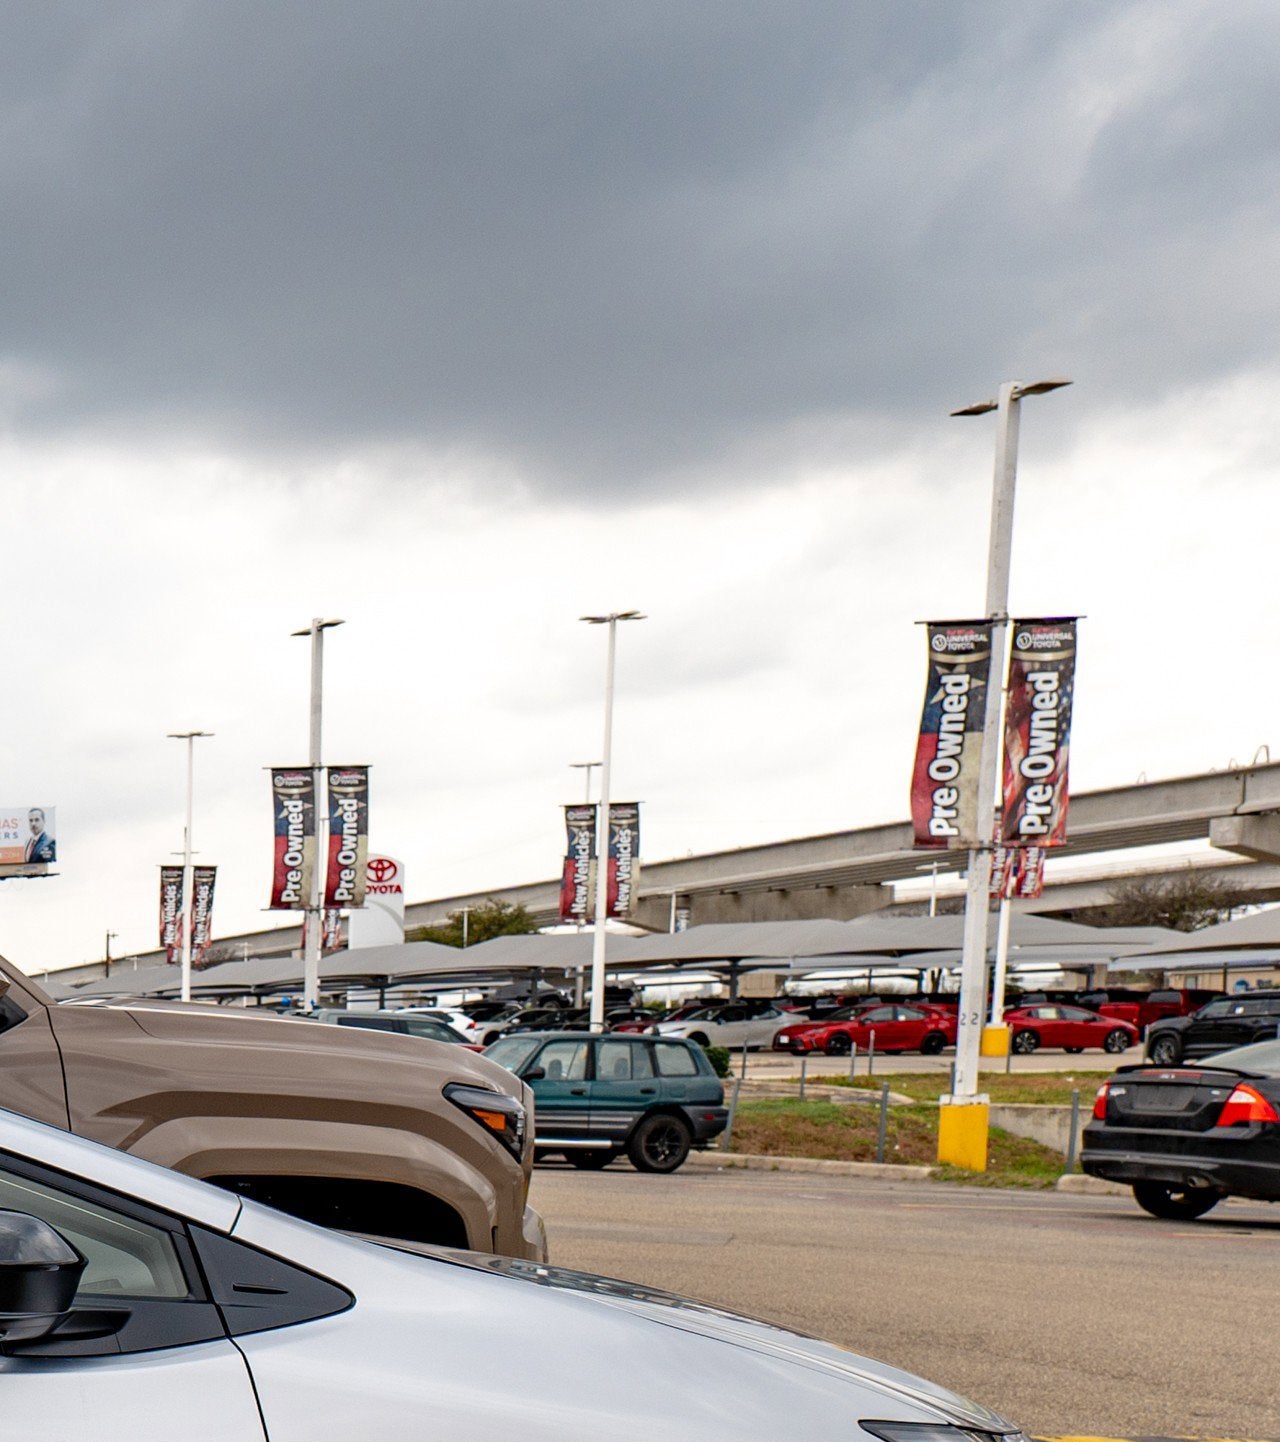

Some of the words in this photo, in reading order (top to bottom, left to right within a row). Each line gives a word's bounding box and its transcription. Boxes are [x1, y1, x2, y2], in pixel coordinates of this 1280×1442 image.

[928, 674, 970, 782] Owned
[1020, 672, 1060, 779] Owned
[283, 800, 304, 867] Owned
[337, 798, 358, 866] Owned
[929, 787, 959, 836] Pre
[1019, 784, 1053, 836] Pre
[574, 830, 590, 883] Vehicles
[616, 829, 632, 881] Vehicles
[281, 869, 302, 902] Pre
[334, 868, 355, 901] Pre
[365, 885, 402, 895] OYOTA
[570, 886, 588, 914] New
[614, 884, 630, 912] New
